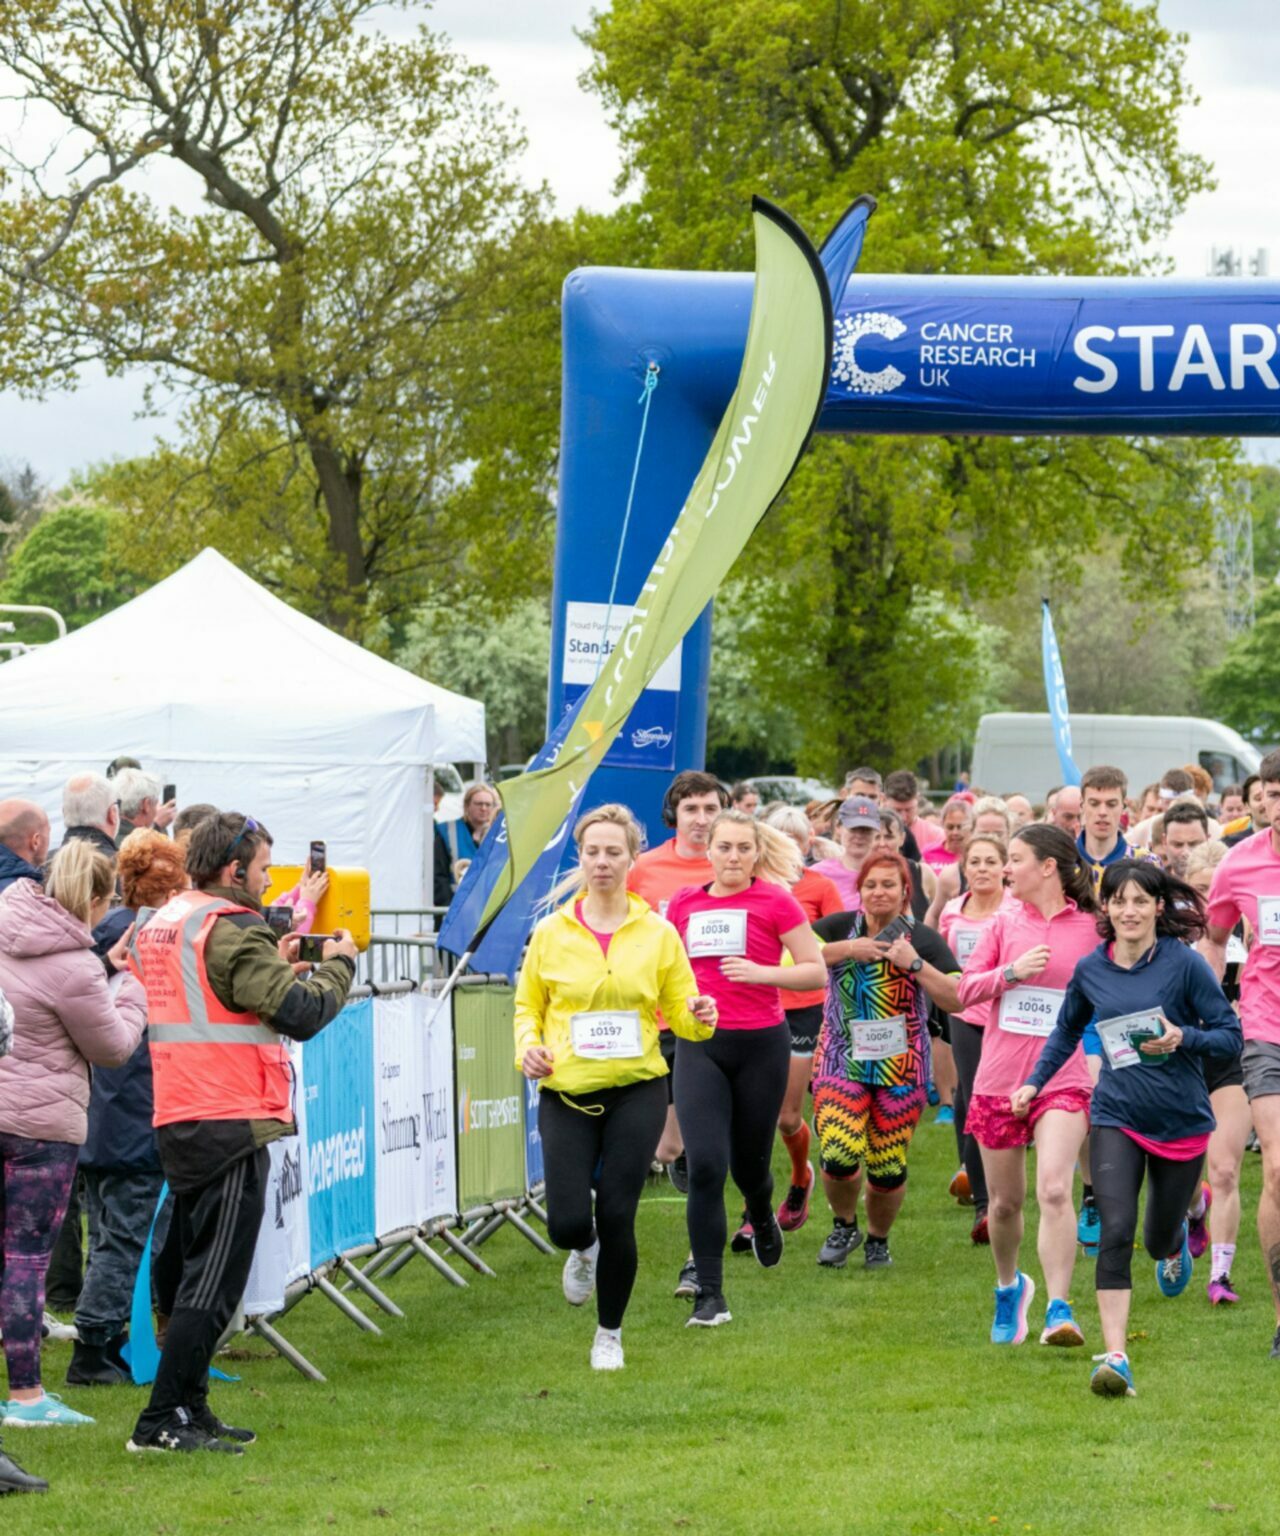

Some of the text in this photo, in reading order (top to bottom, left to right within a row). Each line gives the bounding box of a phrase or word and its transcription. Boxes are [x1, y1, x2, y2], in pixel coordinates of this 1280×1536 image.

[920, 322, 1013, 343] CANCER
[920, 345, 1036, 368] RESEARCH
[920, 368, 950, 387] UK
[592, 621, 622, 631] Parner
[701, 924, 730, 935] 10038
[1018, 1001, 1053, 1014] 10045
[590, 1026, 622, 1037] 10197
[866, 1030, 893, 1041] 10067
